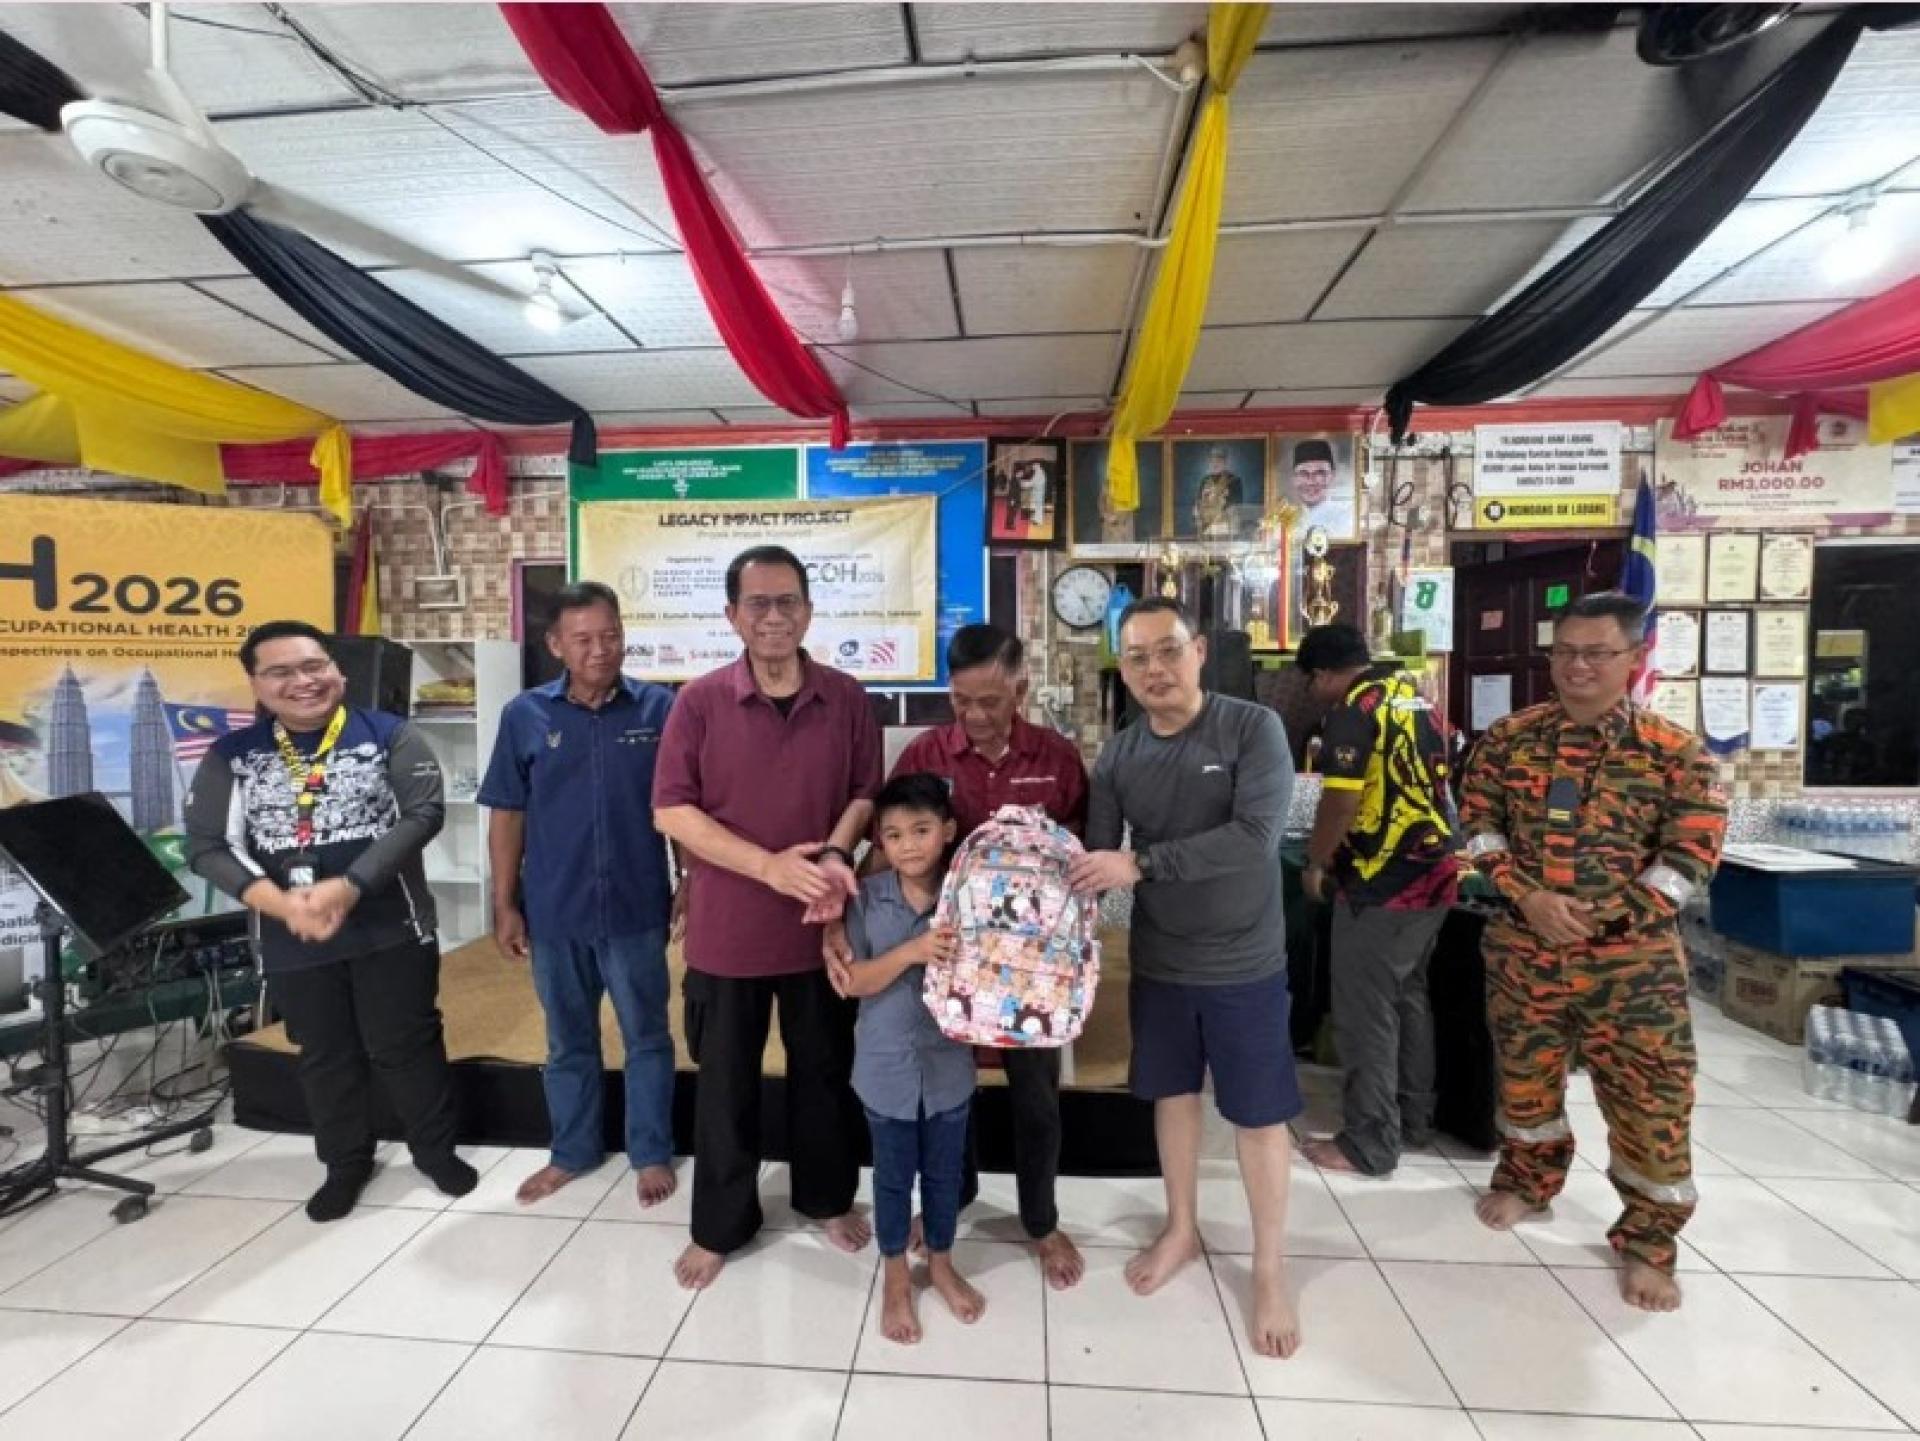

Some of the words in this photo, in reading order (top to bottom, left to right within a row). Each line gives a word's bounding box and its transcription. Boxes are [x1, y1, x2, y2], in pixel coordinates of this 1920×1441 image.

[1738, 460, 1803, 473] JOHAN
[658, 513, 718, 527] LEGACY
[723, 513, 779, 526] IMPACT
[784, 511, 853, 525] PROJECT
[69, 572, 243, 617] 2026
[1417, 581, 1439, 609] 8
[147, 623, 230, 637] HEALTH
[86, 648, 108, 657] on
[114, 647, 218, 659] Occupational
